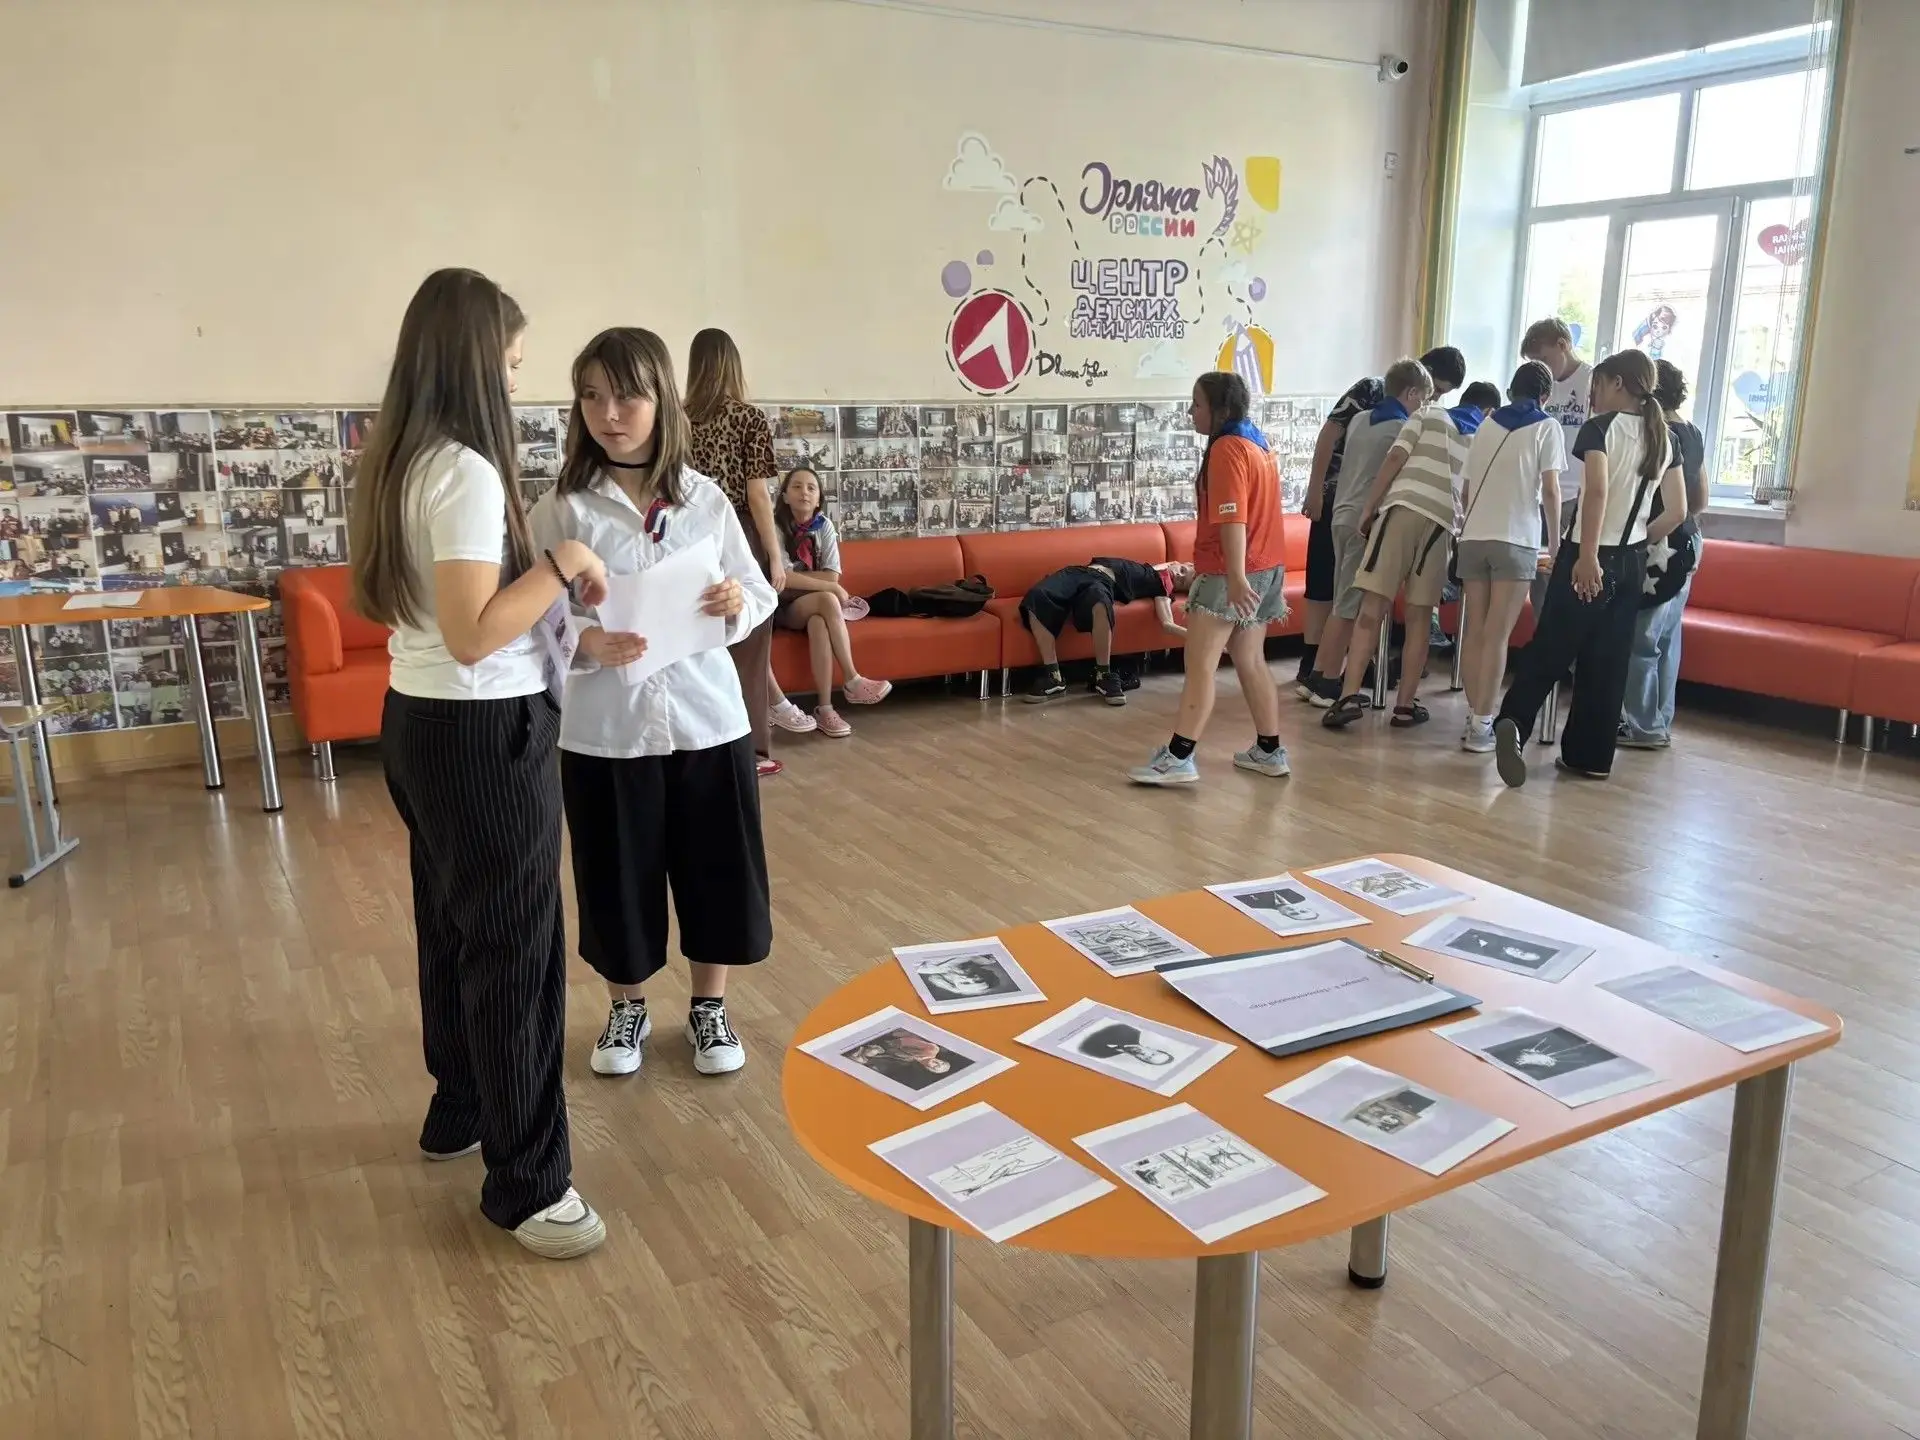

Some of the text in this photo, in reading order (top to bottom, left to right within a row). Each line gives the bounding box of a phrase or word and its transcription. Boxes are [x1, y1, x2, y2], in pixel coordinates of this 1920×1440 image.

[1080, 161, 1200, 220] Орлята
[1110, 213, 1195, 237] РОССИИ
[1071, 258, 1189, 297] ЦЕНТР
[1071, 295, 1180, 321] ДЕТСКИХ
[1070, 318, 1185, 342] ИНИЦИАТИВ
